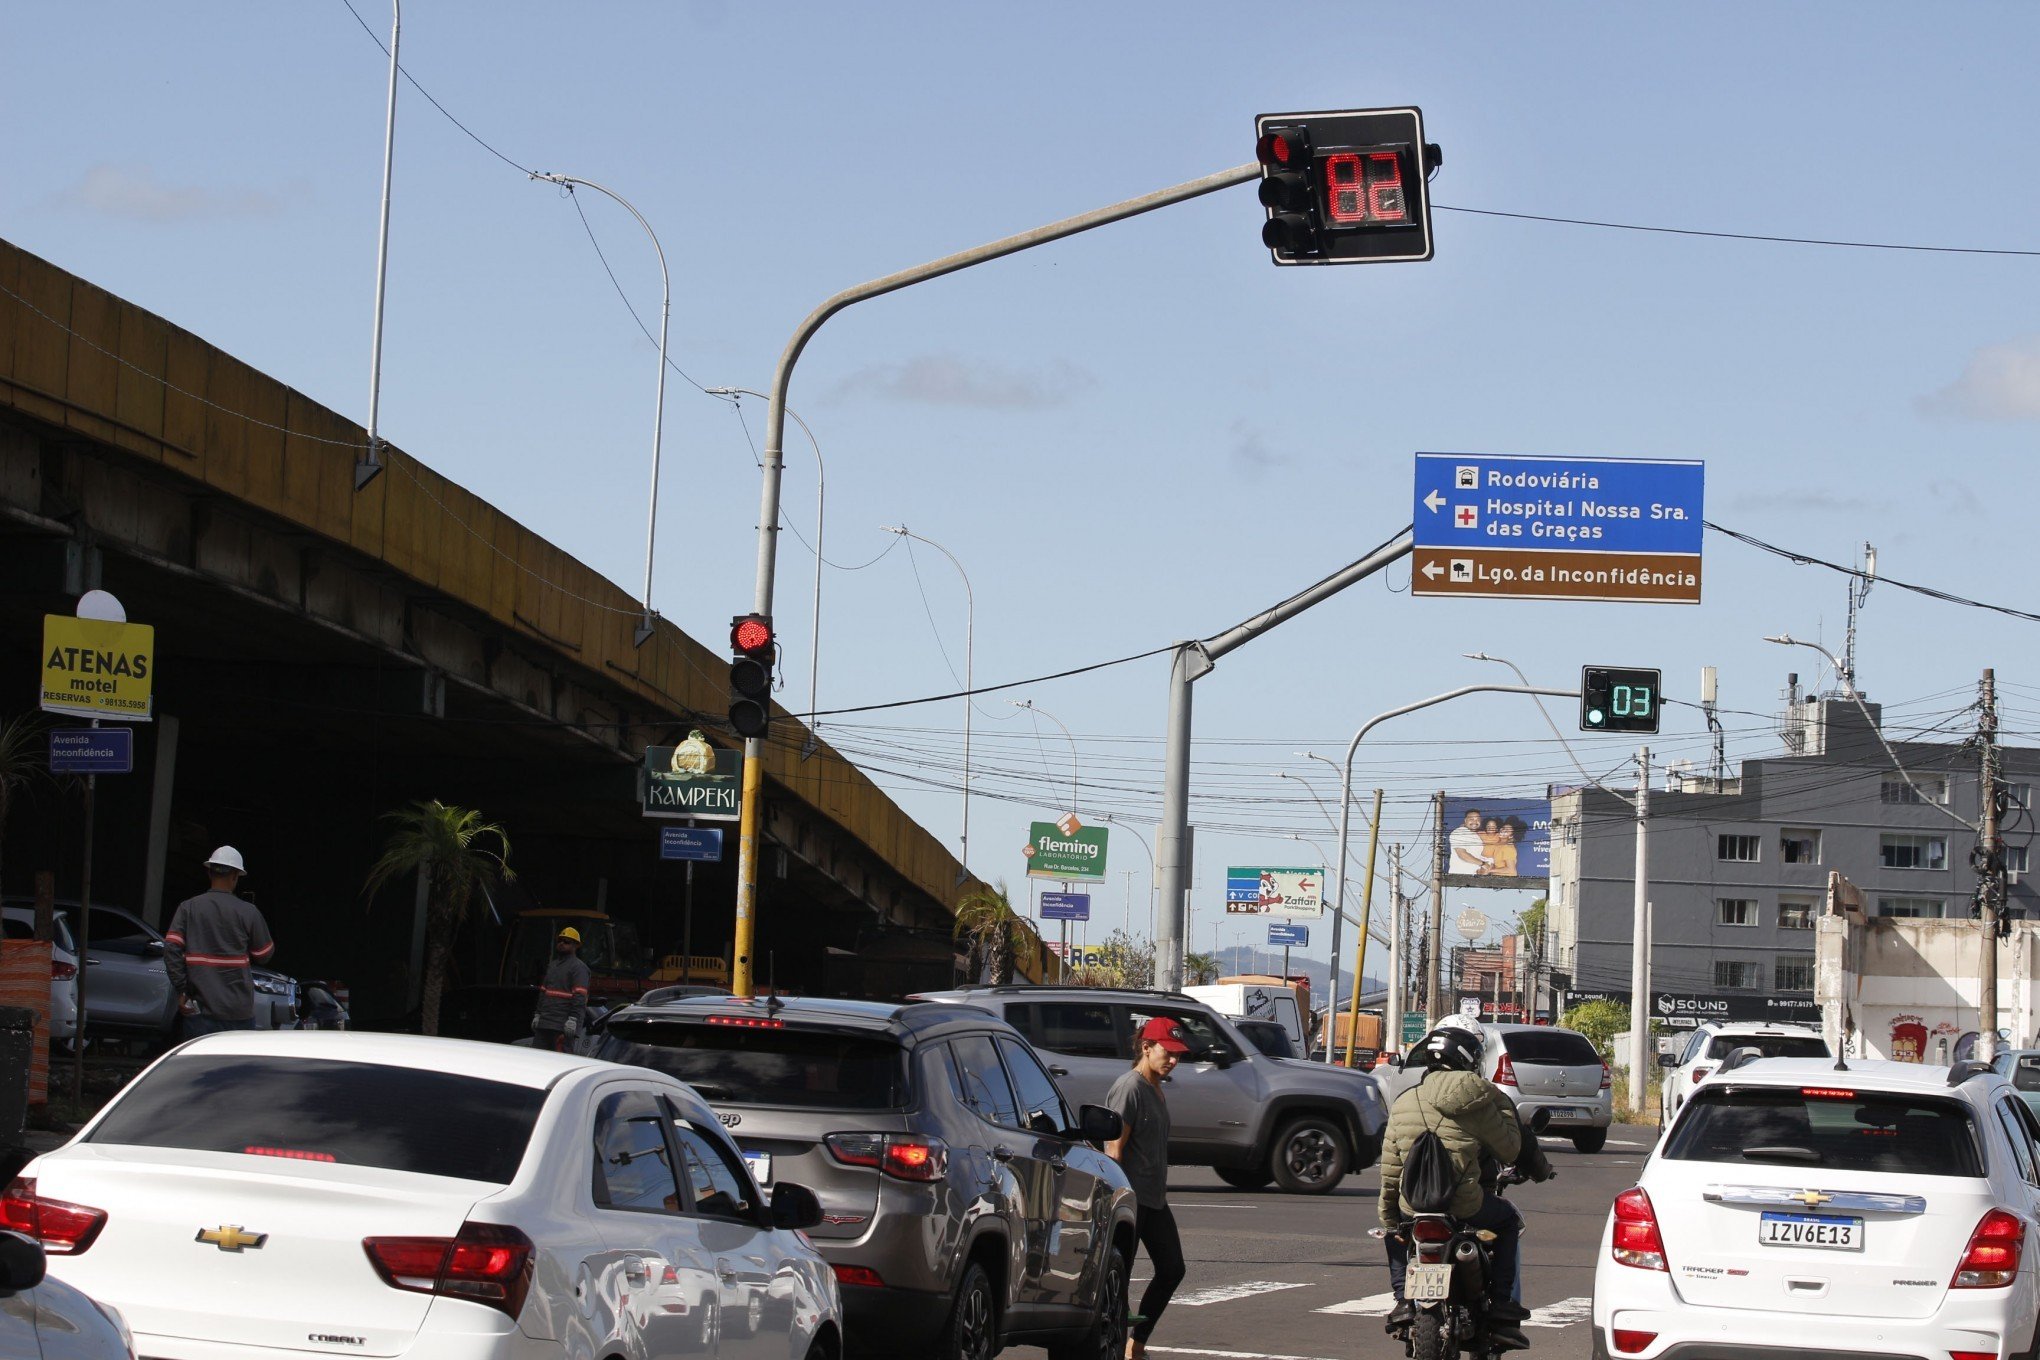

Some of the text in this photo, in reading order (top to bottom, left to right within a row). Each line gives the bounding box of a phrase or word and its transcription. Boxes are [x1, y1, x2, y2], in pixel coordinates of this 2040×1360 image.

[1327, 153, 1404, 221] 82
[1488, 470, 1599, 490] Rodoviária
[1487, 499, 1689, 520] Hospital Nossa Sra.
[1487, 521, 1602, 541] das Graças
[1478, 564, 1696, 586] Lgo. da Inconfidência
[47, 646, 147, 679] ATENAS
[70, 678, 117, 694] motel
[43, 691, 91, 703] RESERVAS
[1613, 685, 1650, 716] 03
[53, 735, 89, 744] Avenida
[53, 748, 114, 757] Inconfidência
[650, 786, 735, 807] KAMPEKI
[1039, 836, 1098, 858] fleming
[1039, 851, 1088, 860] LABORATÓRIO
[1676, 1000, 1728, 1011] SOUND
[1769, 1223, 1851, 1244] IZV6E13
[1682, 1265, 1724, 1274] TRACKER
[1410, 1286, 1445, 1297] 7160
[308, 1334, 367, 1344] COBALT
